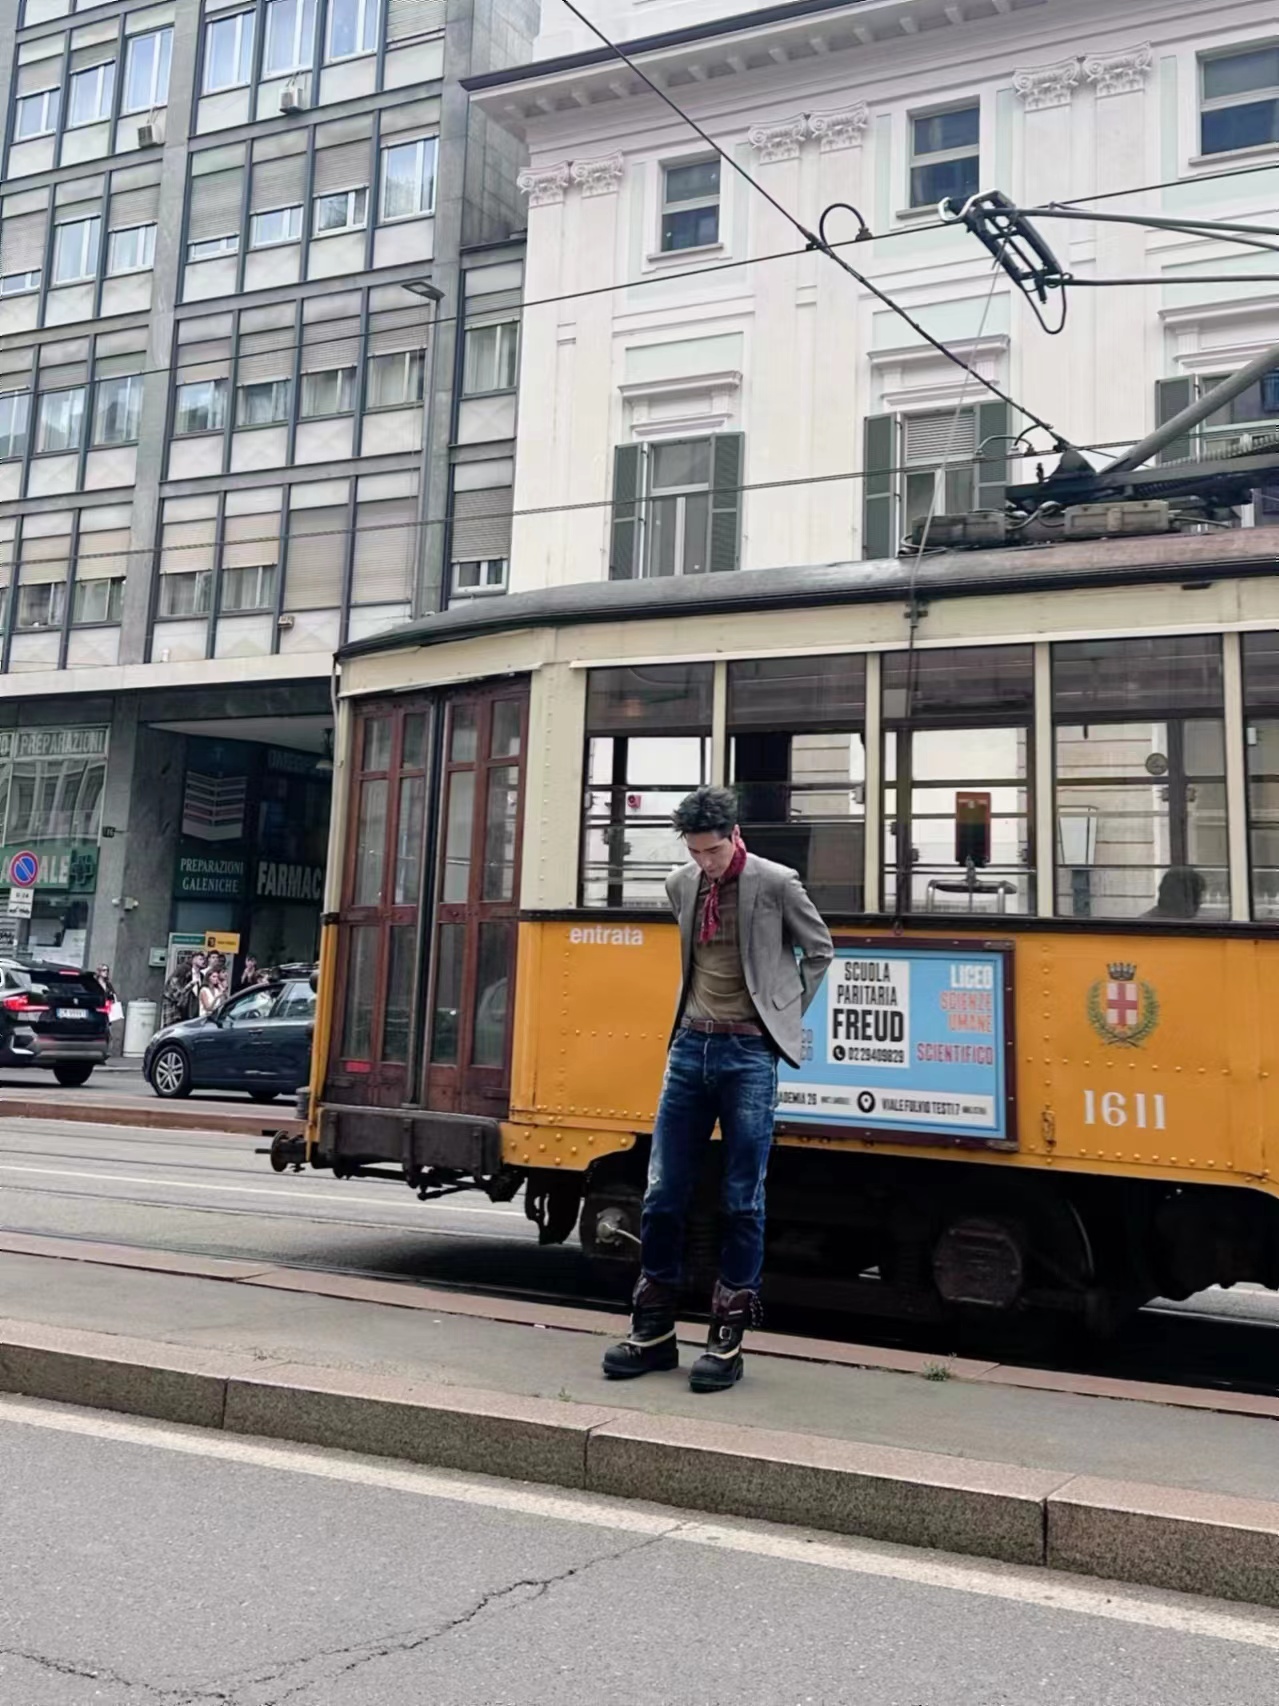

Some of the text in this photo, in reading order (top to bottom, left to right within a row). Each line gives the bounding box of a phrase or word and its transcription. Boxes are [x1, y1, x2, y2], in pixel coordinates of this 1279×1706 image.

[20, 731, 105, 756] PREPARAZIONI
[180, 857, 244, 874] PREPARAZIONI
[182, 876, 240, 893] GALENICHE
[570, 924, 644, 945] entrata
[844, 961, 891, 982] SCUOLA
[950, 964, 993, 989] LICEO
[837, 984, 898, 1006] PARITARIA
[940, 990, 993, 1011] SCIENZE
[832, 1007, 904, 1042] FREUD
[948, 1012, 993, 1033] UMANE
[916, 1042, 994, 1065] SCIENTIFICO
[882, 1098, 904, 1112] VIALE
[1084, 1089, 1166, 1129] 1611
